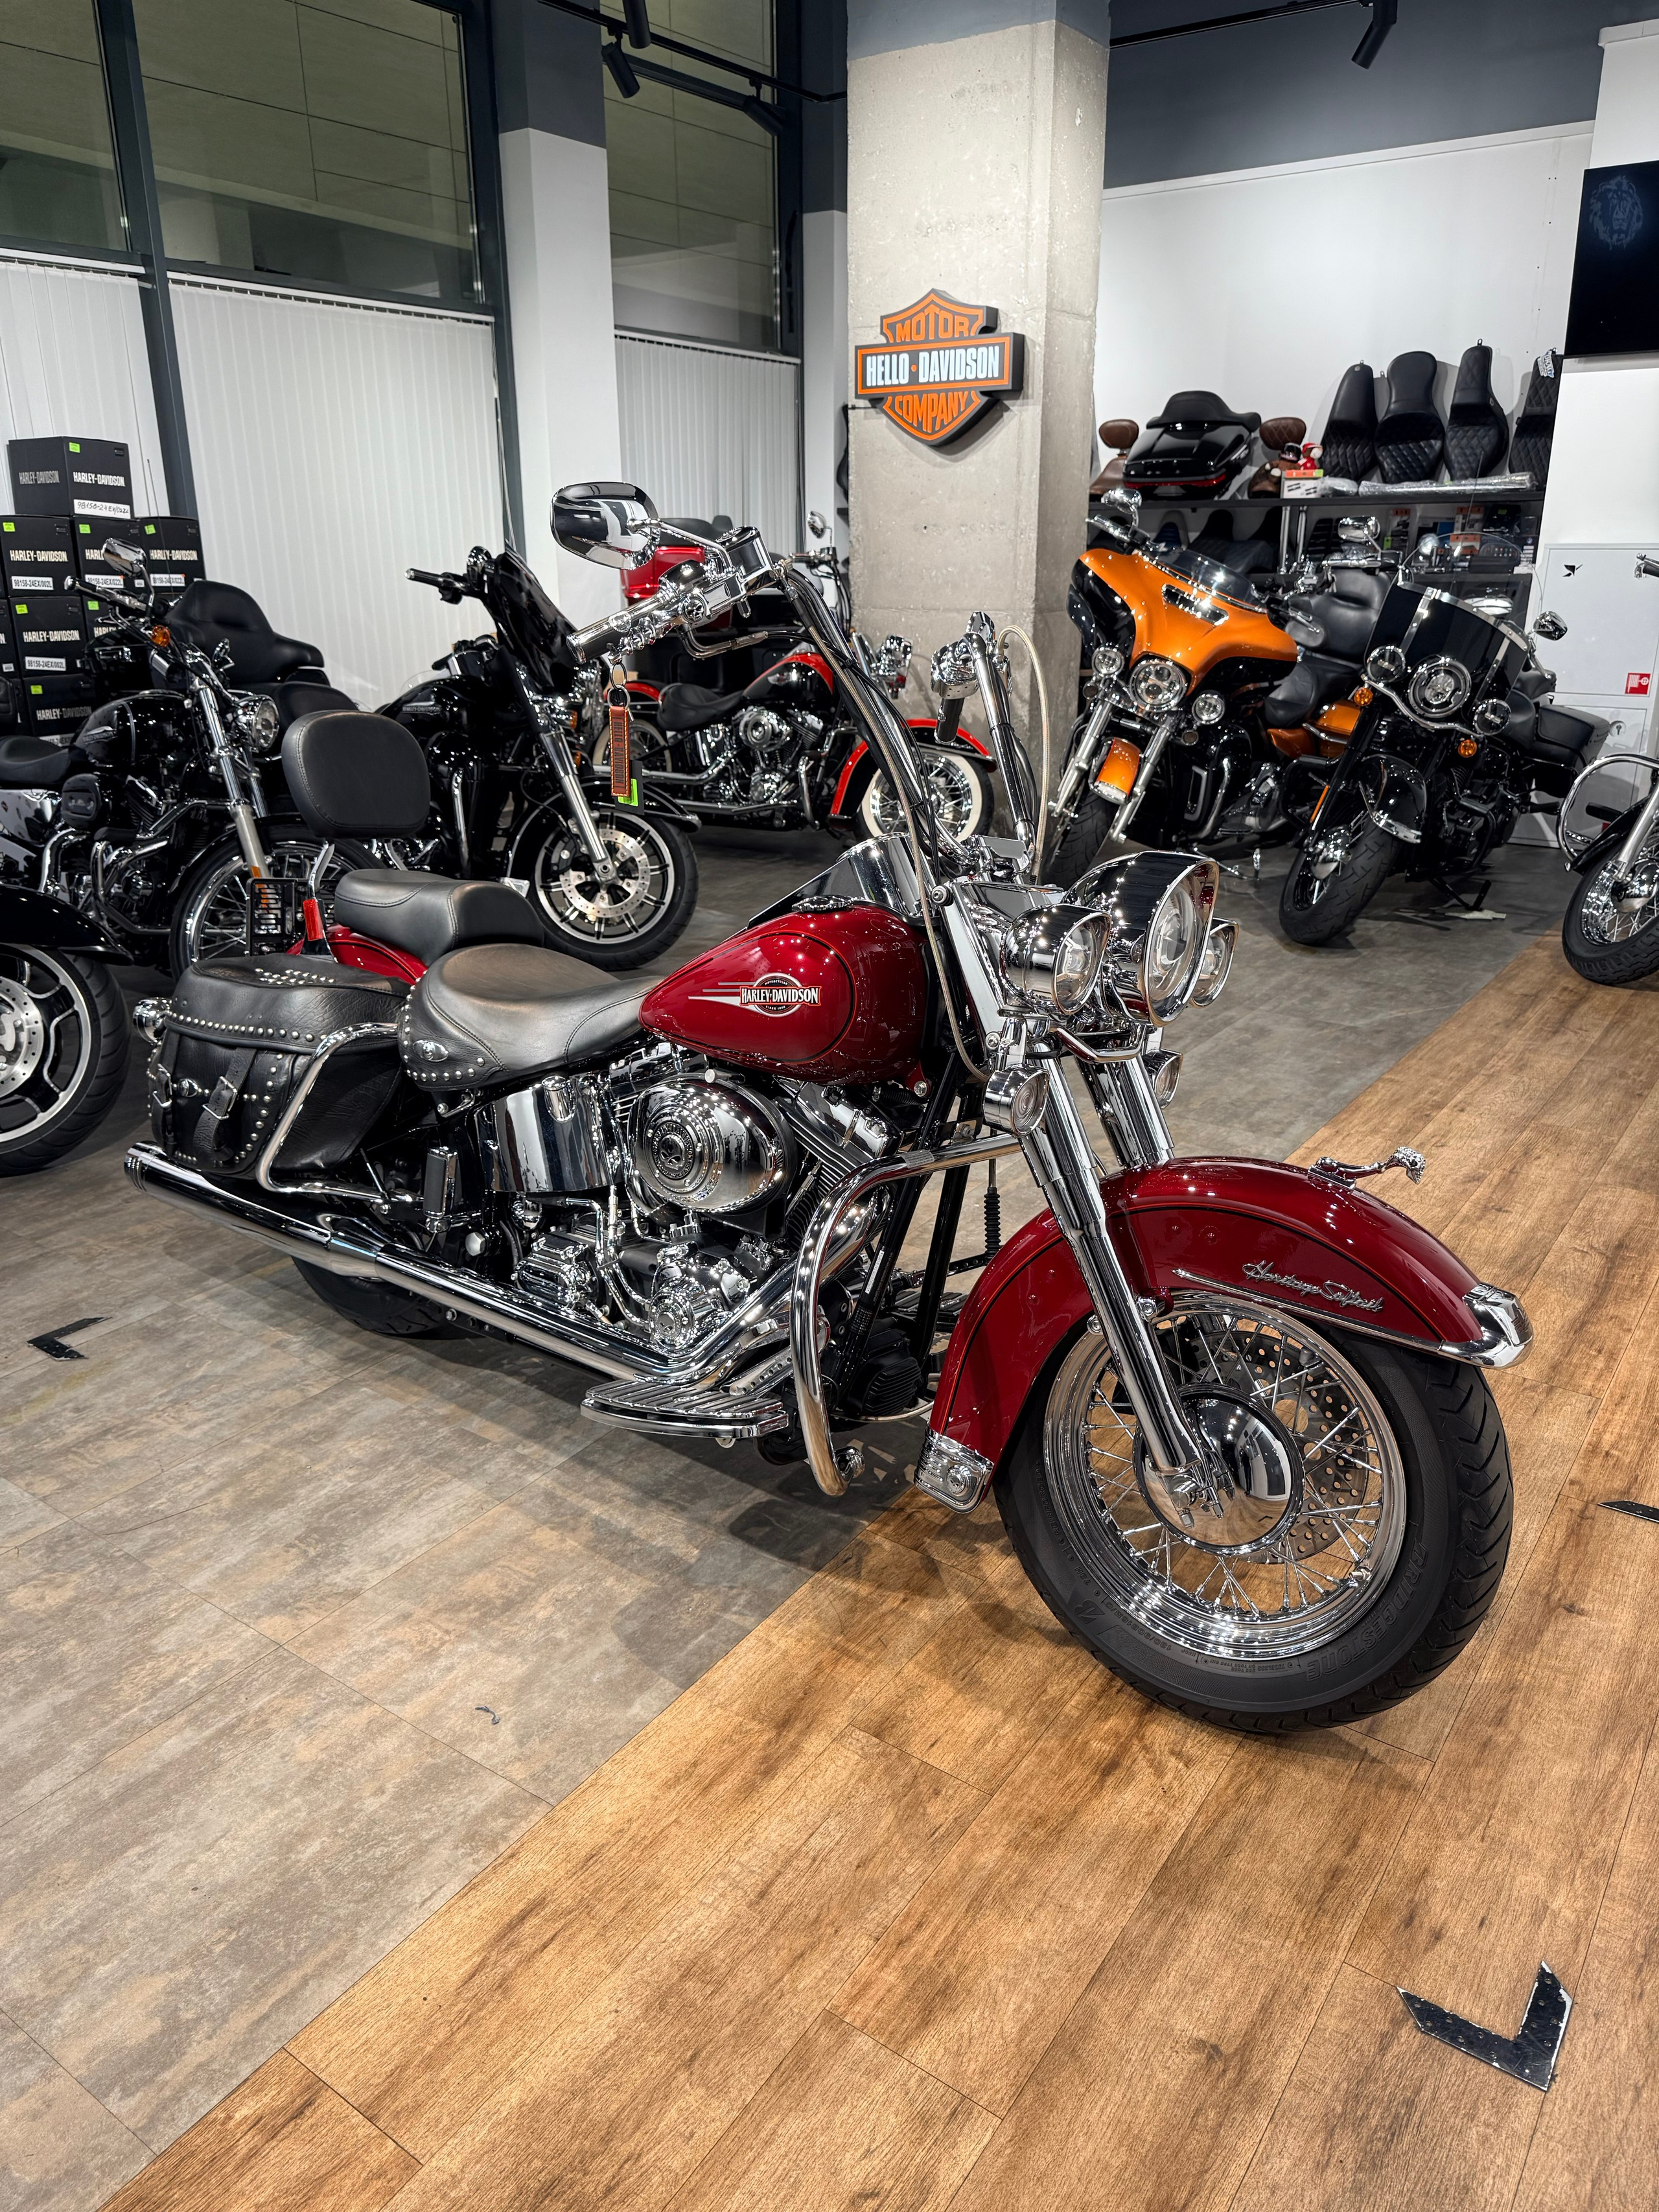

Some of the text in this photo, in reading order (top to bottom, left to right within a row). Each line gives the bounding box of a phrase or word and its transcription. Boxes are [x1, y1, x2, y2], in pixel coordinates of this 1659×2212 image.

[896, 304, 969, 342] MOTOR
[866, 345, 1000, 386] HELLO DAVIDSON
[895, 391, 968, 433] COMPANY
[19, 471, 60, 484] HARLEY-DAVIDSON
[73, 472, 125, 487] HARLEY-DAVIDSON
[10, 550, 68, 562] HARLEY-DAVIDSON
[23, 630, 80, 642] HARLEY-DAVIDSON
[36, 706, 91, 721] HARLEY-DAVIDSON
[613, 721, 625, 784] HELLO DAVIDSON
[741, 988, 820, 1003] HARLEY-DAVIDSON
[1242, 1260, 1384, 1312] Heritage Softail
[1306, 1537, 1430, 1682] BRIDGESTONE
